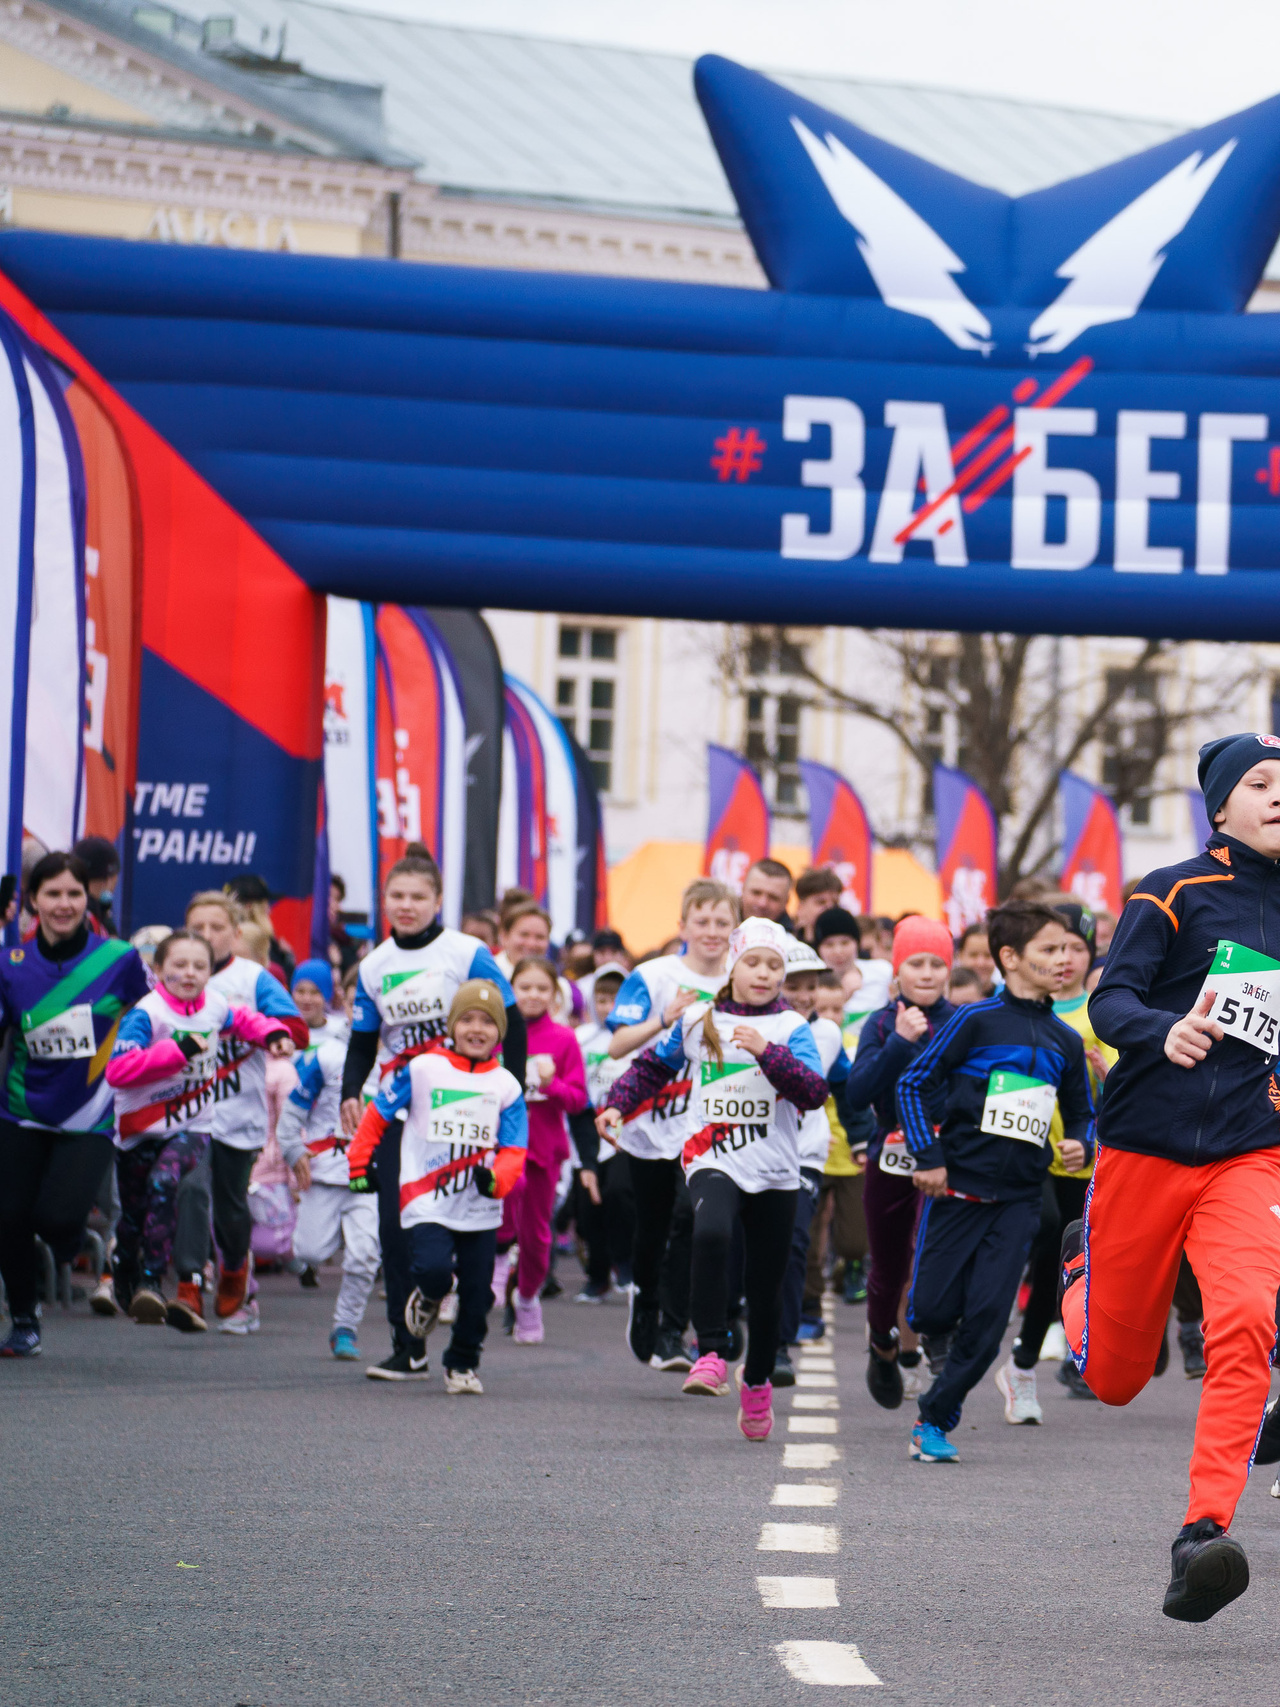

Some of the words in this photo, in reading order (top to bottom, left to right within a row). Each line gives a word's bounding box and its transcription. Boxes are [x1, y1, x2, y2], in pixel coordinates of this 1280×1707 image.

[386, 997, 443, 1019] 15064
[29, 1036, 90, 1055] 15134
[703, 1098, 770, 1118] 15003
[432, 1121, 491, 1141] 15136
[988, 1109, 1047, 1140] 15002
